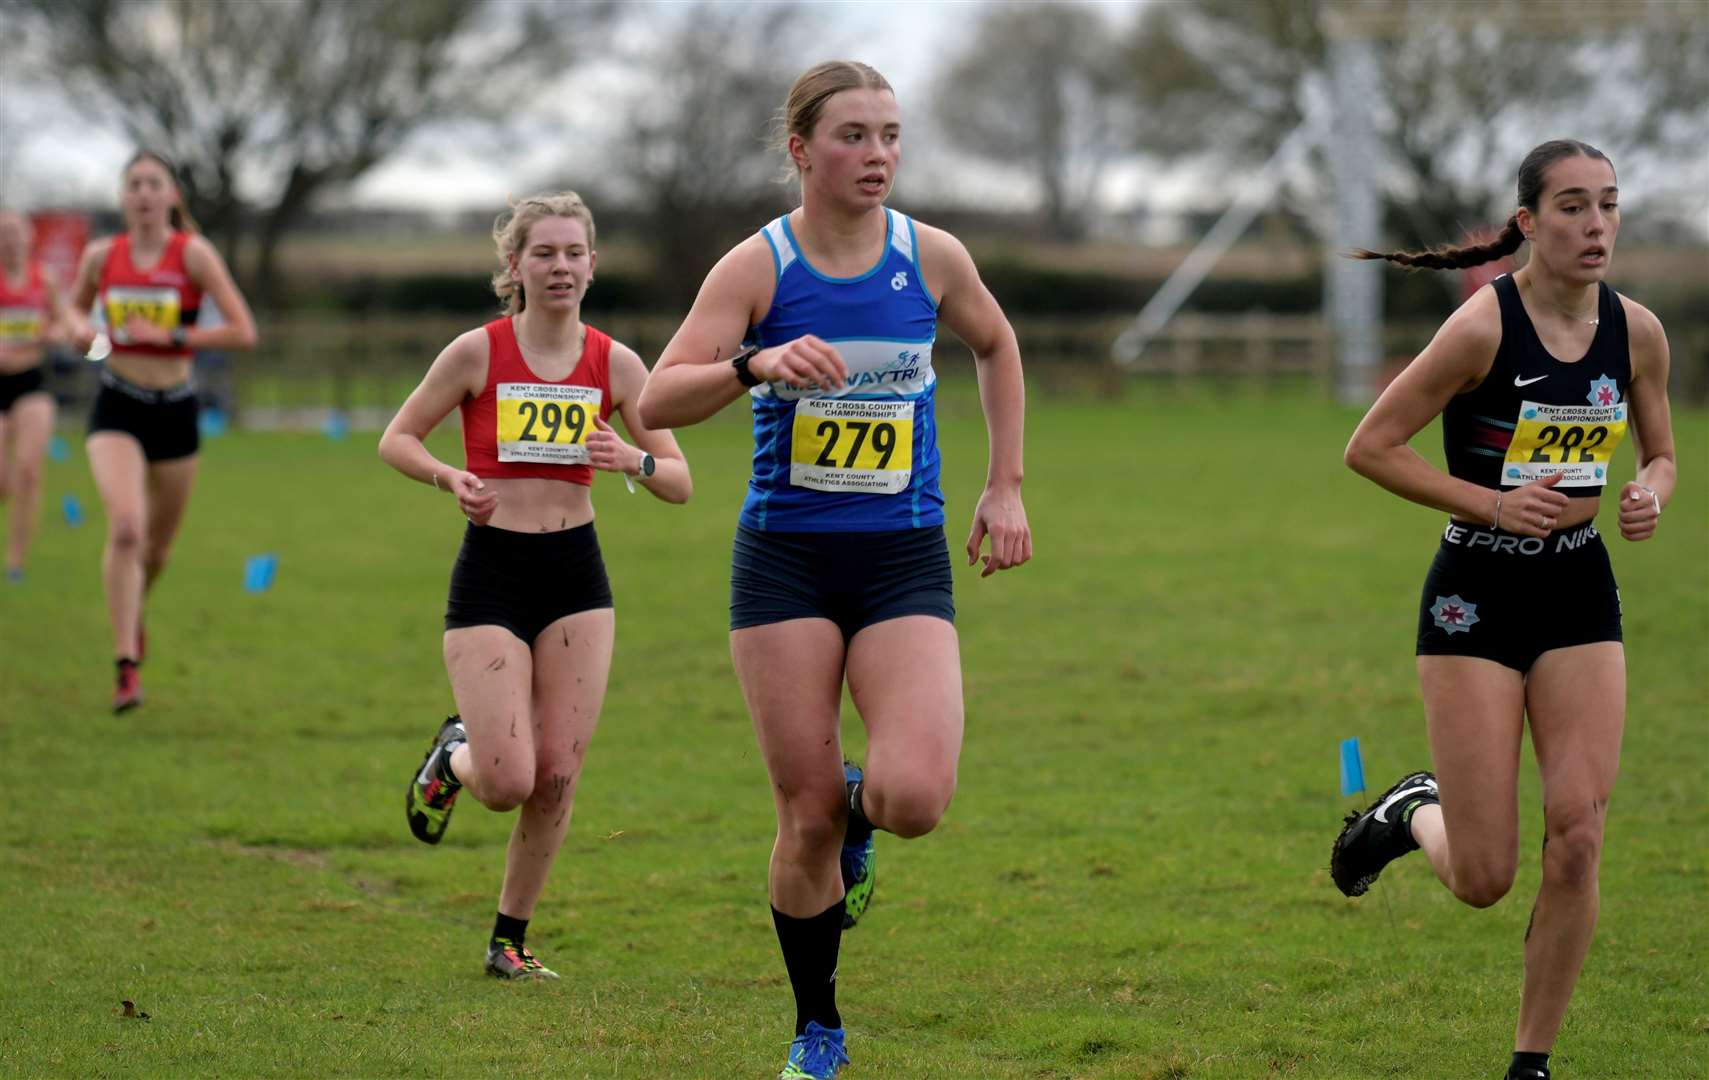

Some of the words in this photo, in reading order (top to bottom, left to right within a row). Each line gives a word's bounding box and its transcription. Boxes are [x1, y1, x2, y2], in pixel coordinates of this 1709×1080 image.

[560, 387, 594, 395] COUNTRY
[809, 400, 833, 408] KENT
[836, 402, 866, 410] CROSS
[868, 402, 907, 410] COUNTRY
[1537, 406, 1560, 414] KENT
[1561, 407, 1587, 415] CROSS
[825, 410, 897, 418] CHAMPIONSHIPS
[518, 401, 586, 444] 299
[815, 420, 896, 470] 279
[1529, 425, 1608, 463] 292
[804, 476, 840, 486] ATHLETICS
[841, 480, 889, 488] ASSOCIATION
[1466, 531, 1545, 555] PRO
